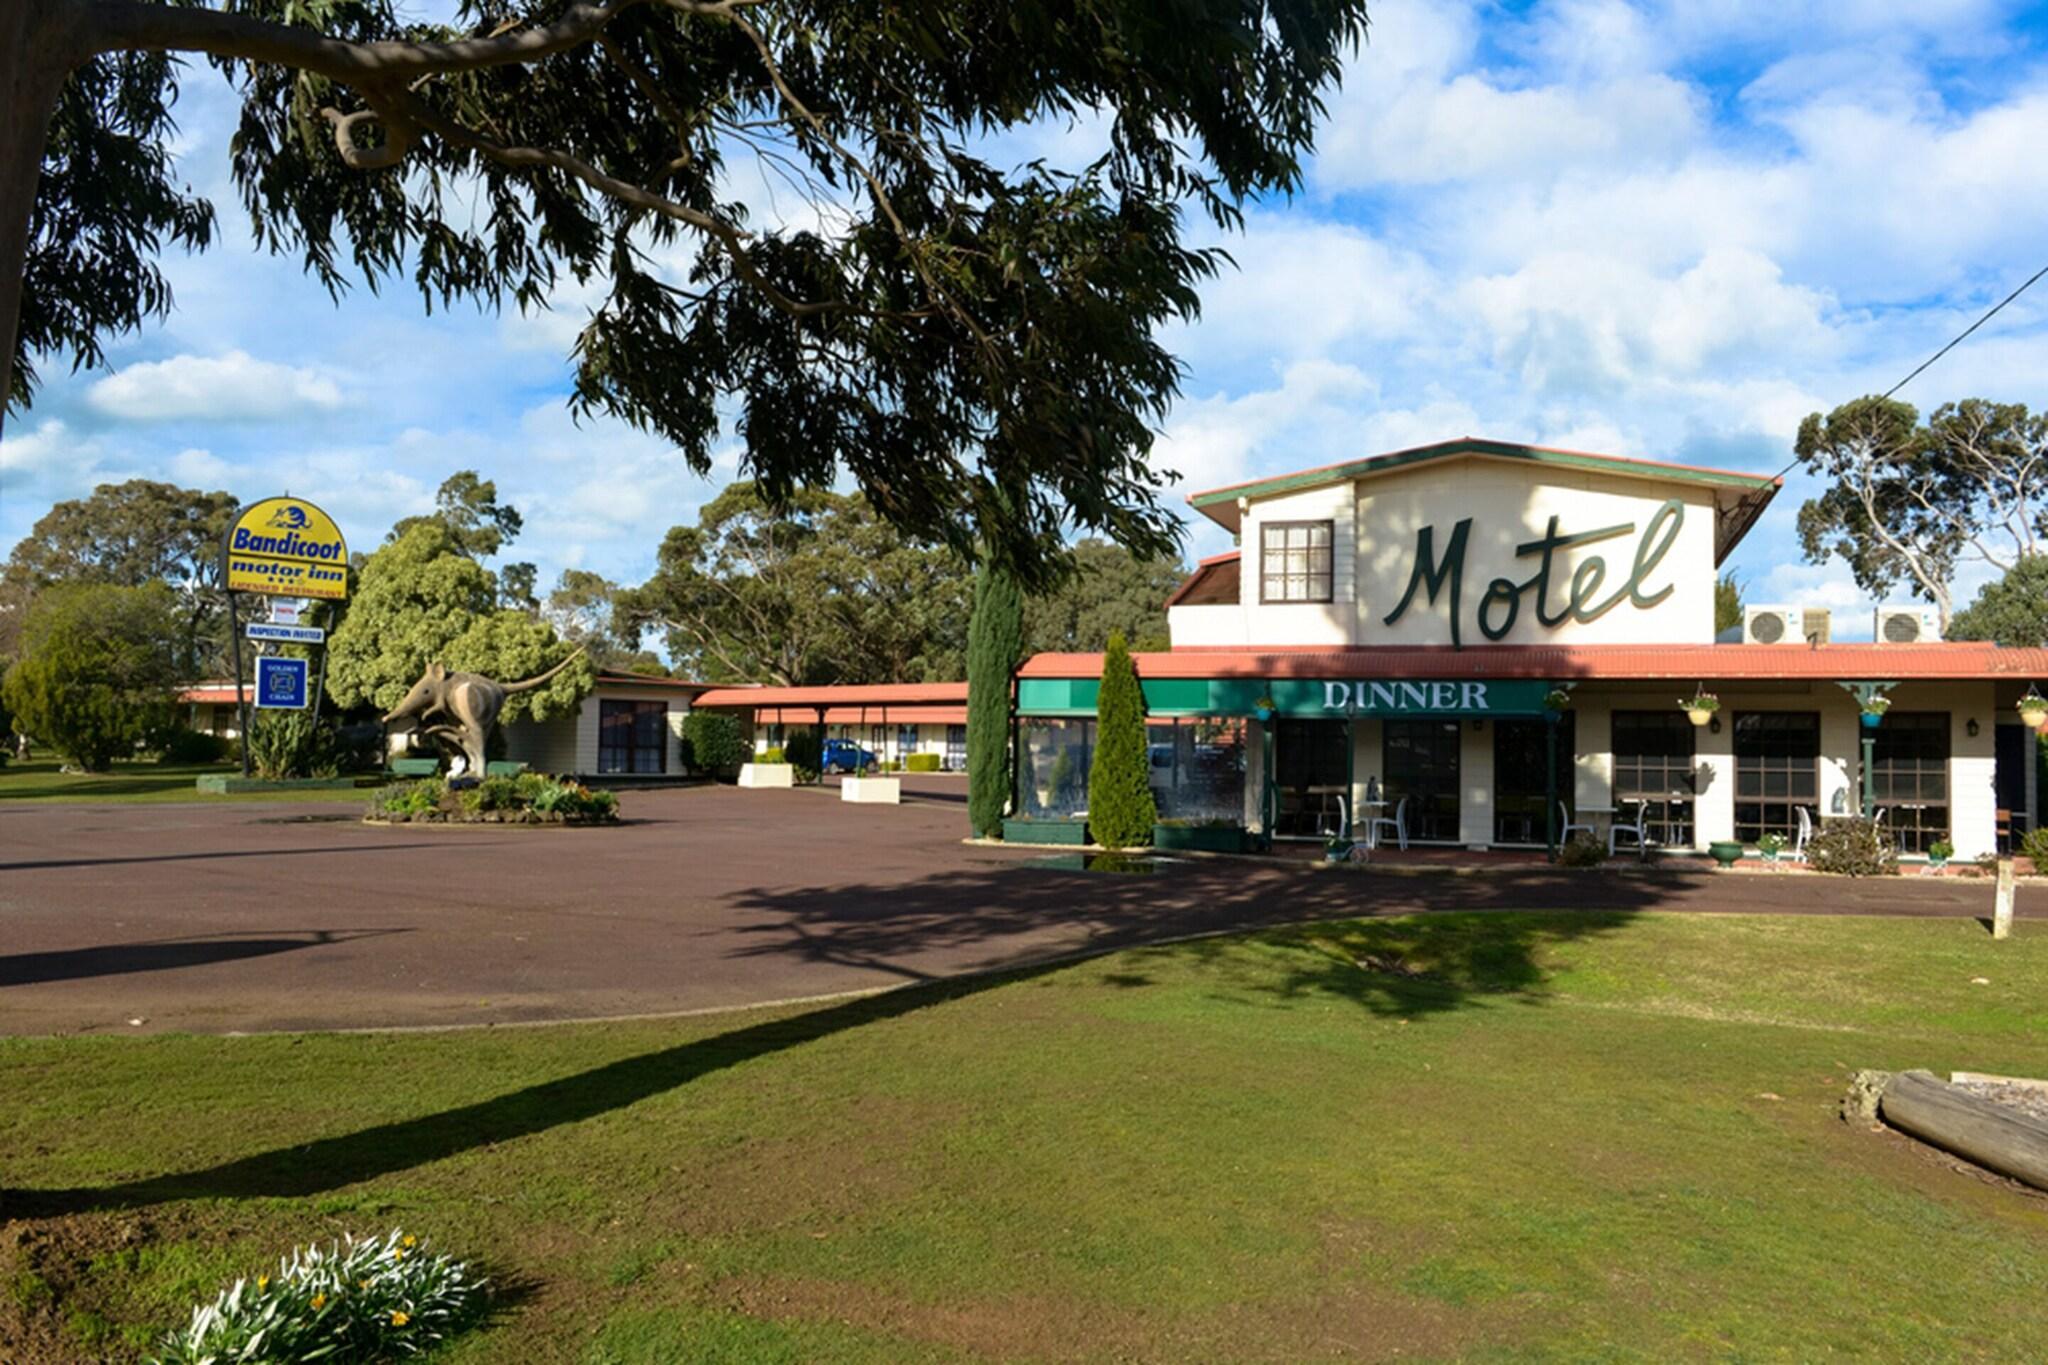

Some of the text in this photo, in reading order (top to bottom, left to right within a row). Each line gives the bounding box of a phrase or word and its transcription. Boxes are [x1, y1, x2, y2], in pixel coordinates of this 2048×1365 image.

[233, 528, 342, 560] Bandicoot
[232, 561, 343, 581] motor inn
[1382, 498, 1685, 652] Motel
[1322, 681, 1489, 709] DINNER
